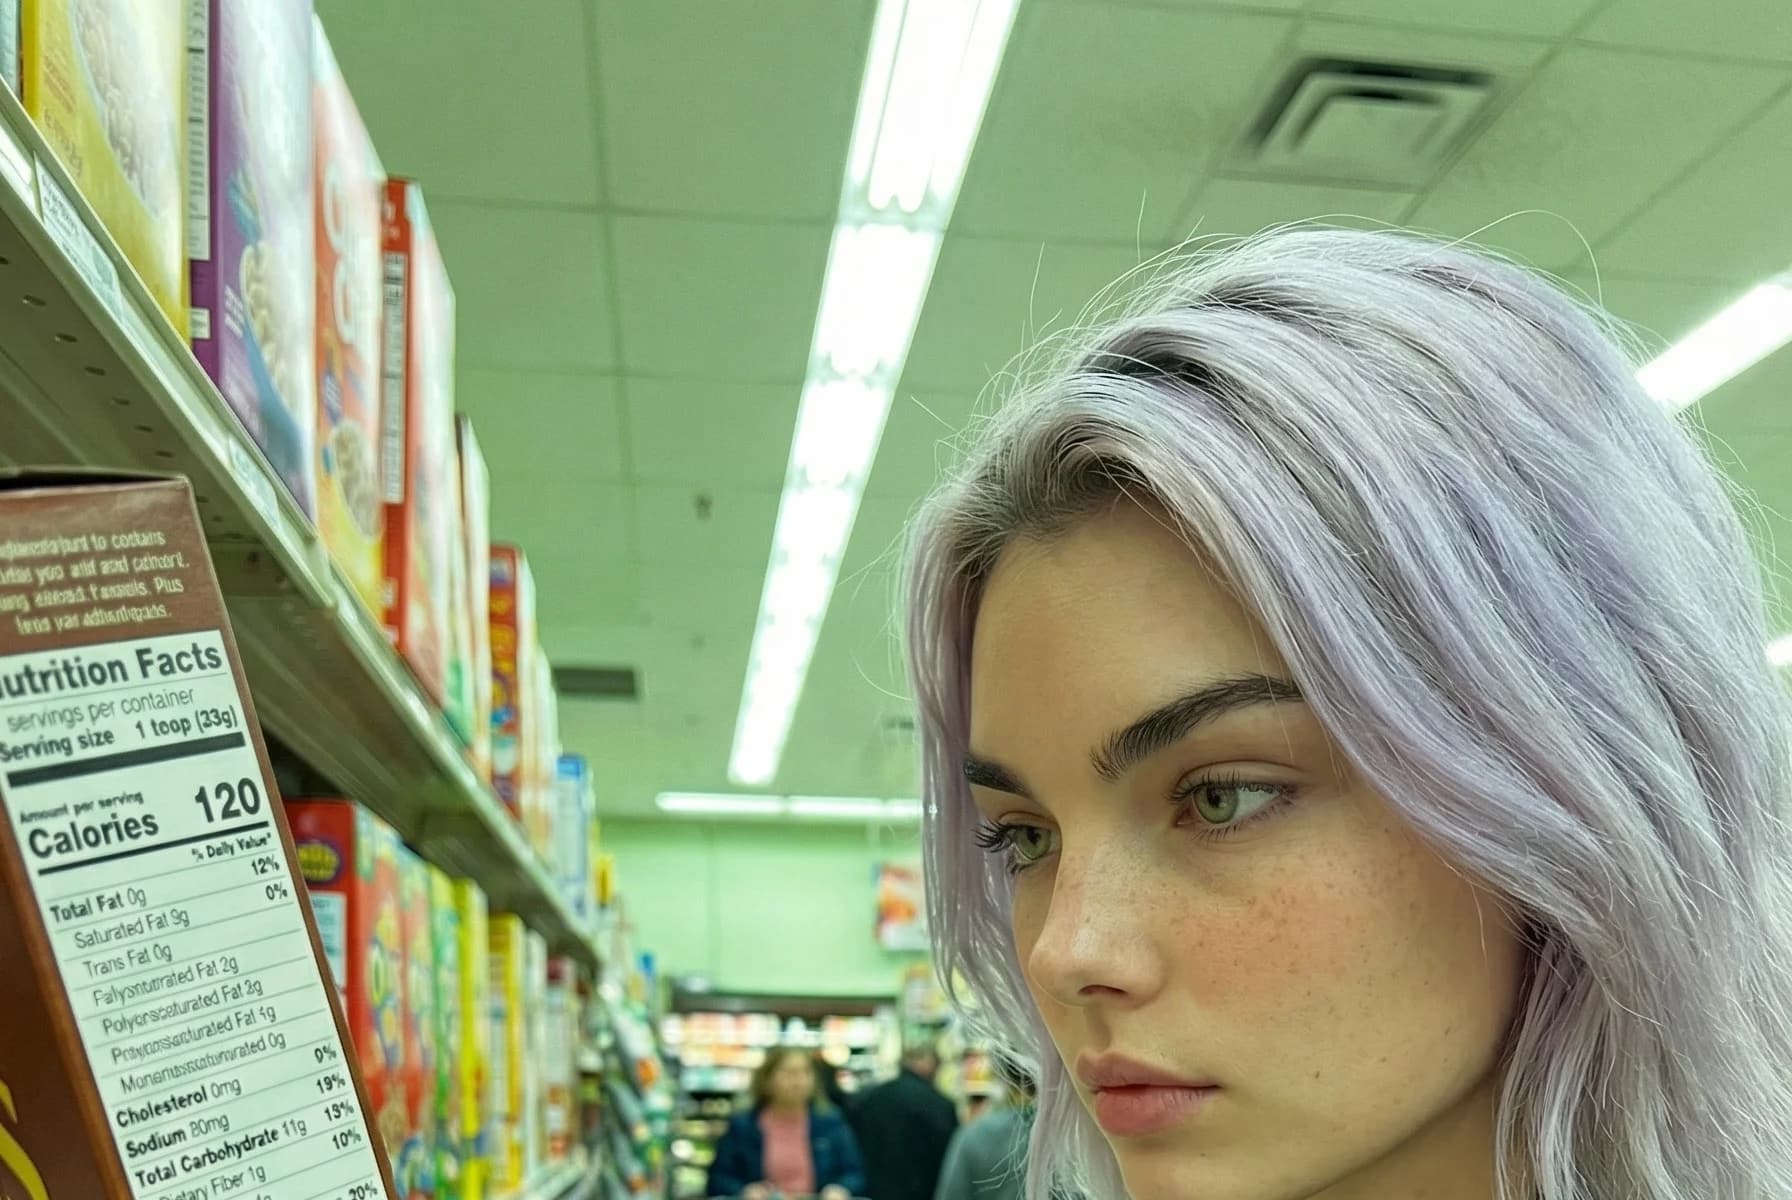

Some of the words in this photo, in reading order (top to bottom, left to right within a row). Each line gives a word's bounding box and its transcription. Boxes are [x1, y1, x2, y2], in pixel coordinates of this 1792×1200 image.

[135, 643, 222, 678] Facts
[8, 702, 84, 733] servings
[88, 700, 115, 723] per
[120, 688, 194, 715] container
[0, 735, 73, 763] Serving
[78, 728, 115, 749] size
[135, 720, 146, 740] 1
[20, 802, 68, 824] Amount
[73, 800, 94, 817] per
[99, 791, 144, 810] serving
[28, 812, 159, 859] Calories
[194, 777, 261, 824] 120
[251, 854, 280, 876] 12%
[50, 899, 92, 923] Total
[96, 892, 124, 912] Fat
[265, 881, 288, 901] 0%
[74, 918, 144, 949] Saturated
[146, 912, 169, 931] Fat
[82, 959, 125, 978] Trans
[127, 948, 149, 966] Fat
[196, 960, 219, 979] Fat
[221, 984, 244, 1002] Fat
[234, 1010, 257, 1028] Fat
[116, 1086, 208, 1129] Cholesterol
[210, 1078, 242, 1099] 0mg
[126, 1127, 187, 1159] Sodium
[317, 1072, 347, 1095] 19%
[135, 1160, 177, 1188] Total
[180, 1126, 279, 1173] Carbohydrate
[211, 1171, 244, 1195] Fiber
[247, 1164, 266, 1184] 1g
[332, 1127, 361, 1151] 10%
